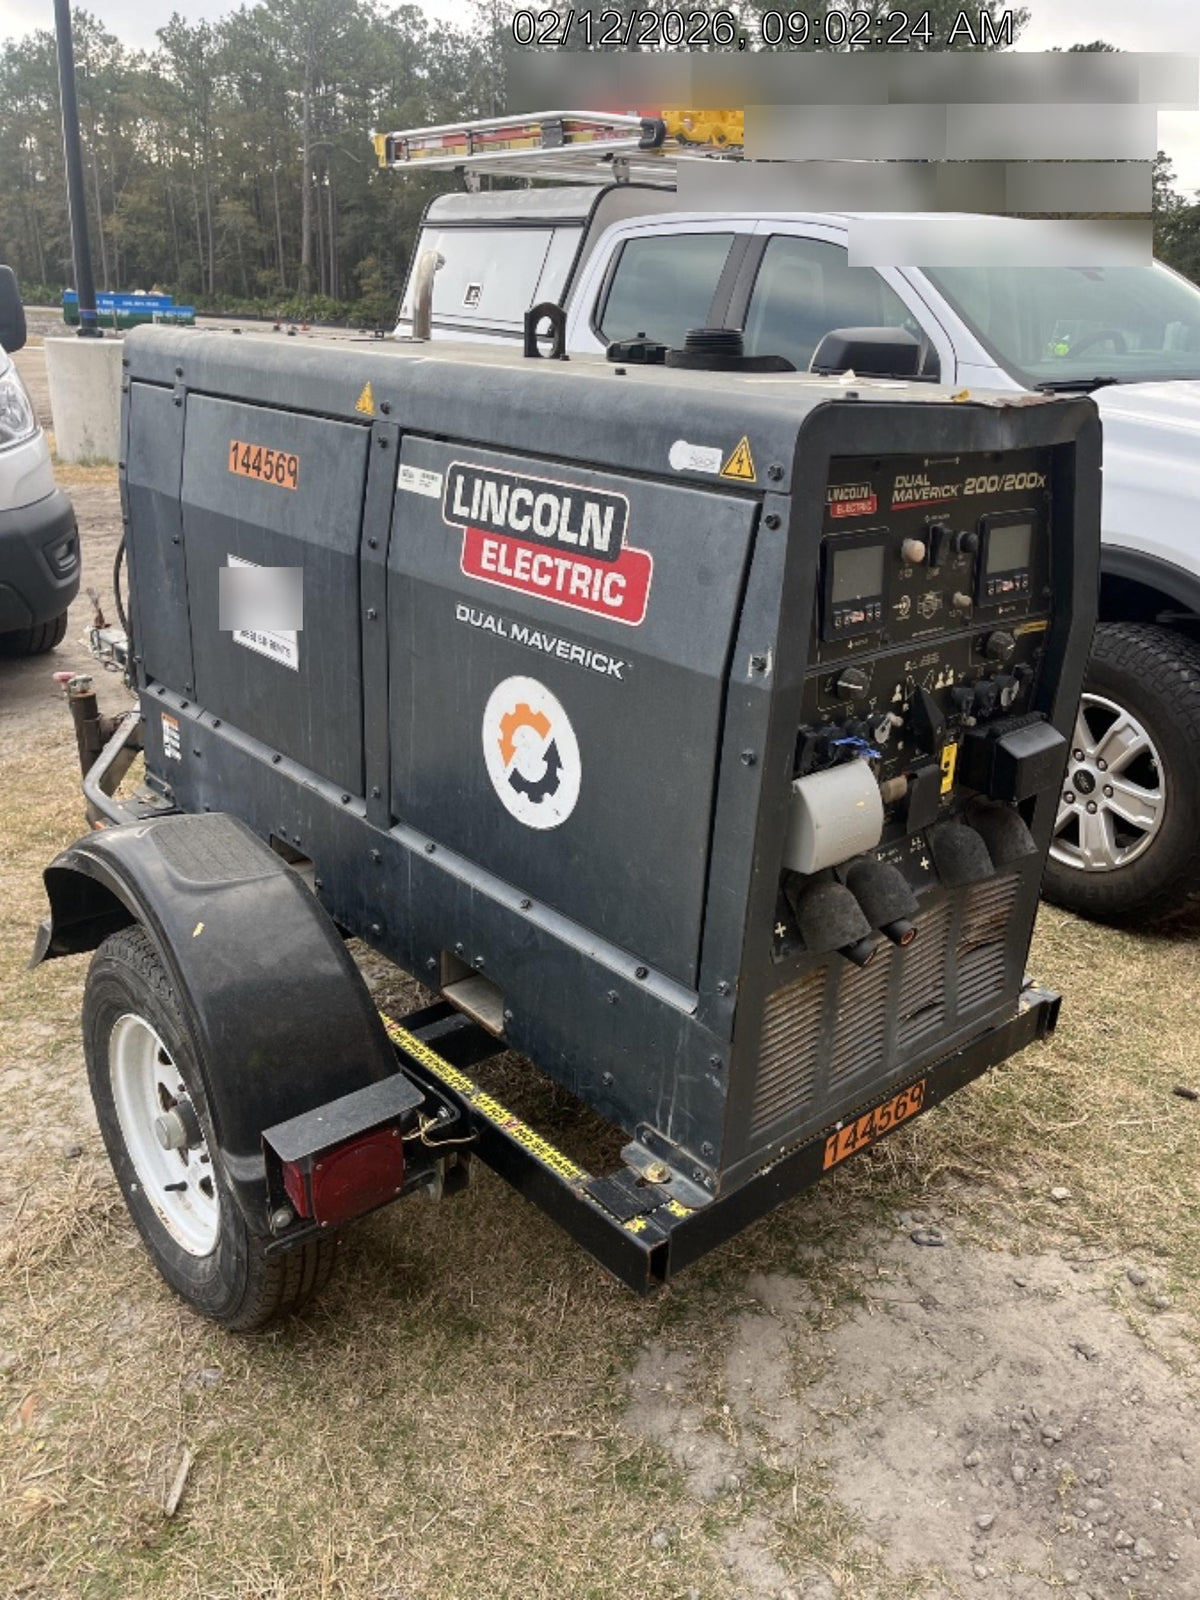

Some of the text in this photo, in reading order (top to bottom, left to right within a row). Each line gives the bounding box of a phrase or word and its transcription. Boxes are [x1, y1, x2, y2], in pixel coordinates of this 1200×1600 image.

[231, 441, 298, 488] 144569
[827, 485, 869, 502] LINCOLN
[895, 474, 931, 489] DUAL
[452, 474, 615, 552] LINCOLN
[892, 485, 960, 503] MAVERICK
[480, 538, 627, 607] ELECTRIC
[456, 603, 626, 680] DUAL MAVERICK
[828, 1080, 924, 1163] 144569
